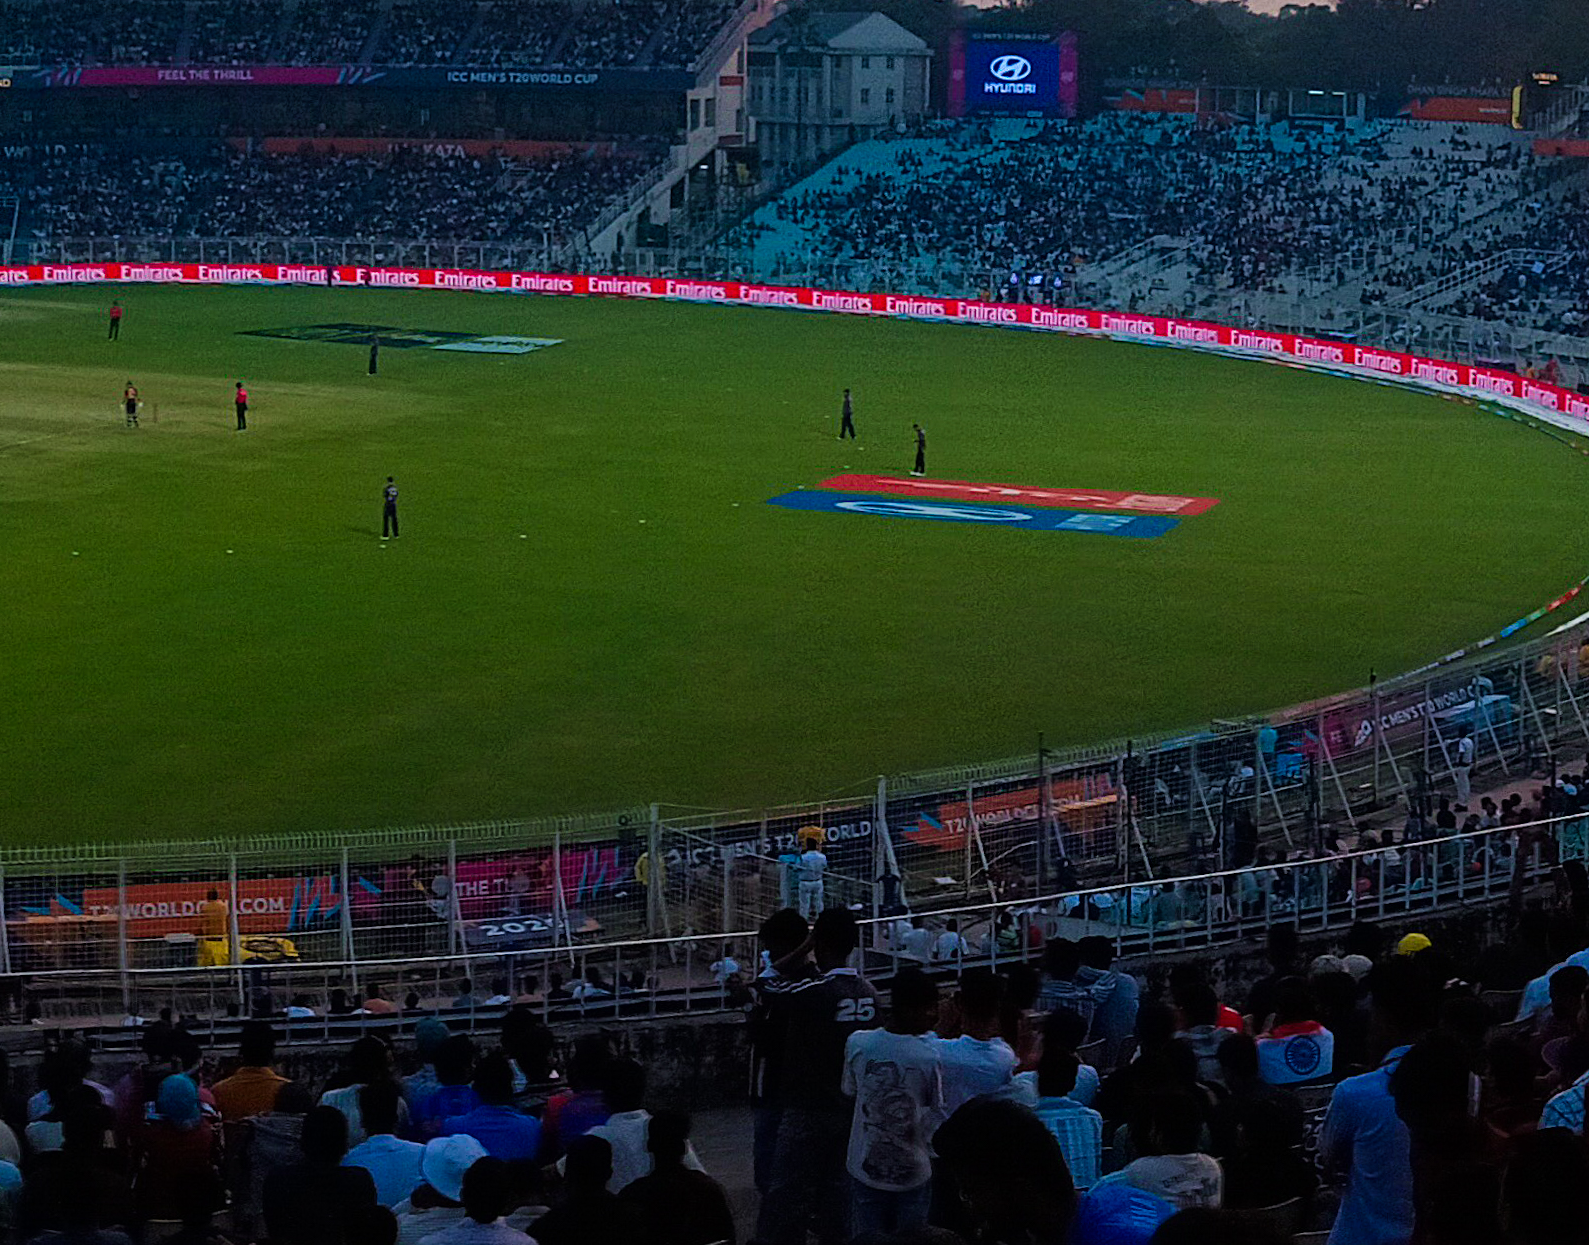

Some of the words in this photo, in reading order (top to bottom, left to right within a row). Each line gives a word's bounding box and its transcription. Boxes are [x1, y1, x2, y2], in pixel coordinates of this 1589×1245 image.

[158, 69, 187, 81] FEEL
[189, 69, 210, 80] THE
[213, 69, 254, 81] THRILL
[447, 71, 468, 83] ICC
[470, 72, 506, 83] MEN'S
[508, 73, 529, 83] T20
[529, 73, 572, 84] WORLD
[574, 74, 599, 84] CUP
[983, 82, 1037, 94] HYUNDAI
[43, 266, 105, 281] Emirates
[121, 265, 183, 280] Emirates
[198, 265, 263, 280] Emirates
[277, 267, 341, 281] Emirats
[435, 271, 497, 288] Emirates
[511, 273, 573, 291] Emirates
[588, 277, 651, 294] Emirates
[666, 281, 727, 299] Emirates
[740, 285, 798, 304] Emirates
[813, 291, 872, 309] Emirates
[885, 297, 945, 315] Emirates
[957, 301, 1017, 321] Emirates
[1031, 307, 1088, 327] Emirates
[1101, 315, 1155, 335] Emirates
[1167, 321, 1219, 342] Emirates
[1231, 329, 1283, 353] Emirates
[1295, 338, 1343, 363] Emirates
[1355, 347, 1401, 373] Emirates
[1411, 358, 1459, 385] Emirates
[1469, 369, 1514, 396] Emirates
[1521, 381, 1559, 409] Emirates
[1389, 705, 1420, 725] MEN'S
[827, 821, 871, 842] ORLD
[455, 879, 489, 897] THE
[836, 997, 875, 1022] 25
